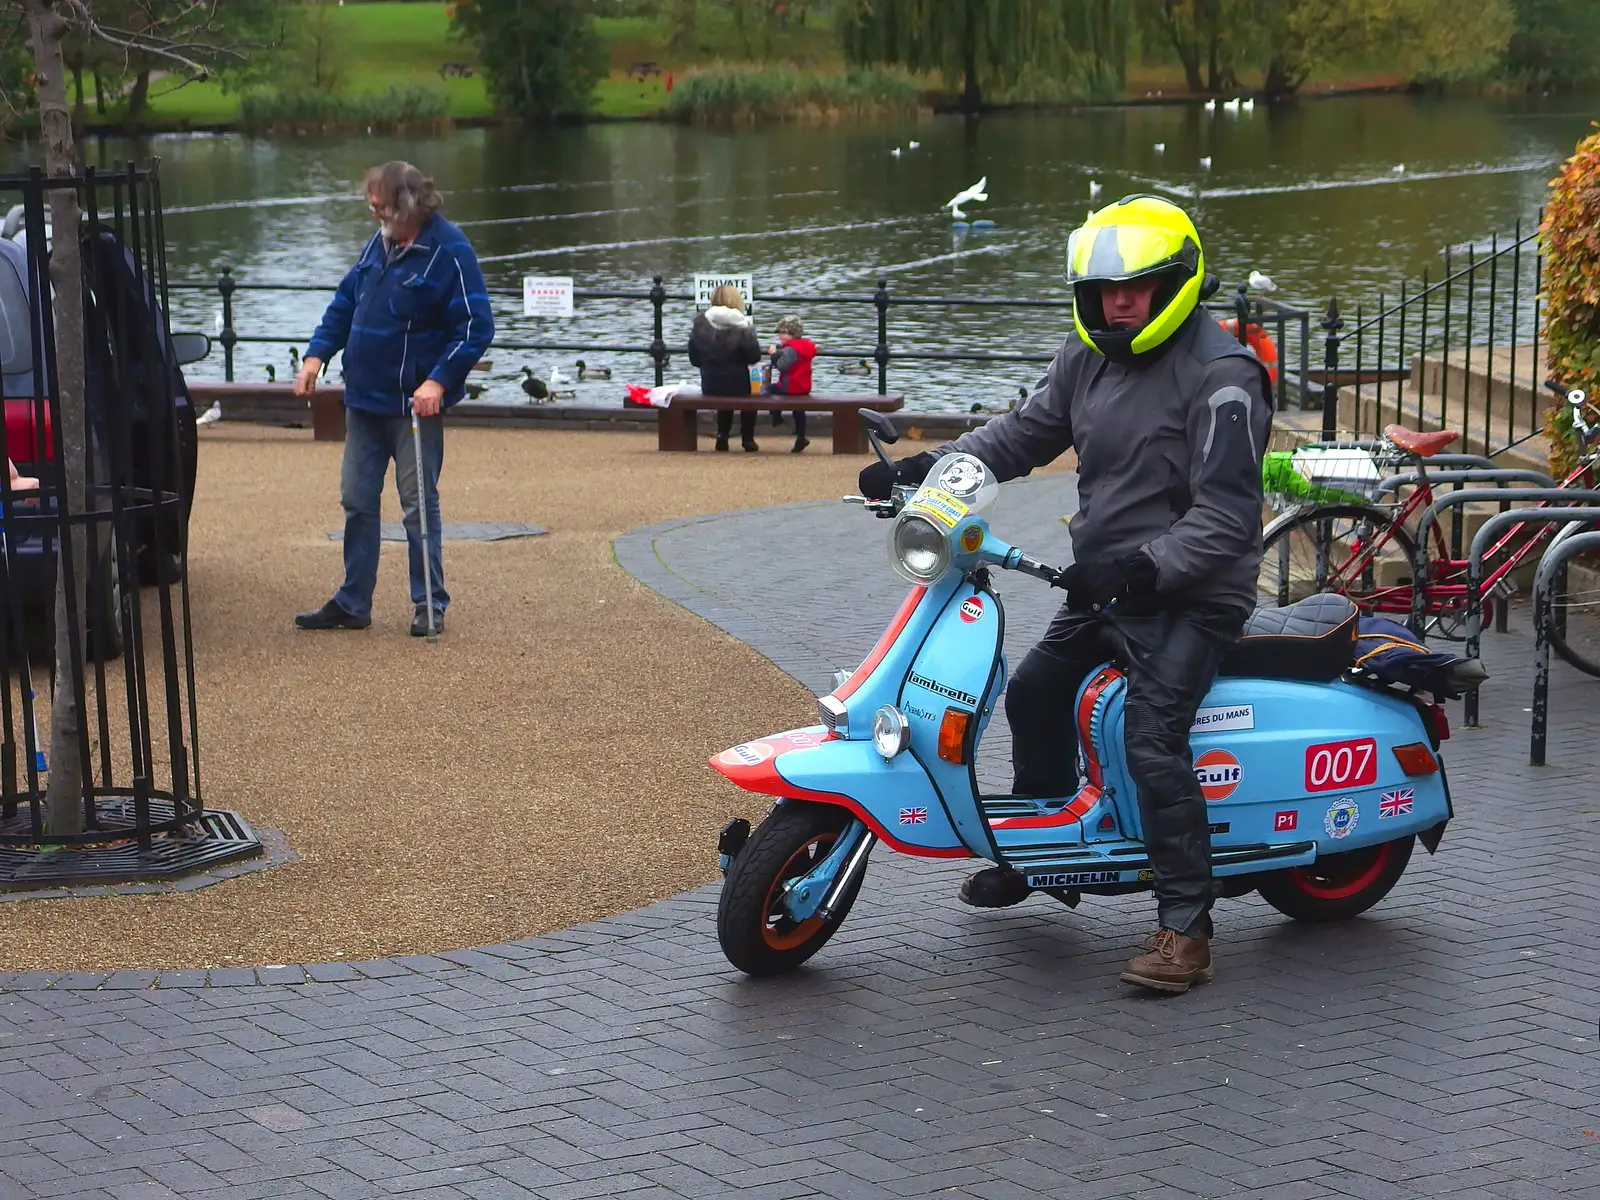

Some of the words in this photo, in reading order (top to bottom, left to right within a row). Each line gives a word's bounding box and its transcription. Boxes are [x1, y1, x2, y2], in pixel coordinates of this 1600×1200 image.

[699, 279, 749, 288] PRIVATE
[962, 602, 982, 617] Gulf
[1212, 713, 1224, 723] DU
[1225, 708, 1250, 720] MANS
[733, 745, 760, 765] Gulf
[1310, 744, 1373, 786] 007
[1194, 768, 1240, 783] Gulf
[1277, 814, 1294, 828] P1
[1032, 871, 1119, 887] MICHELIN
